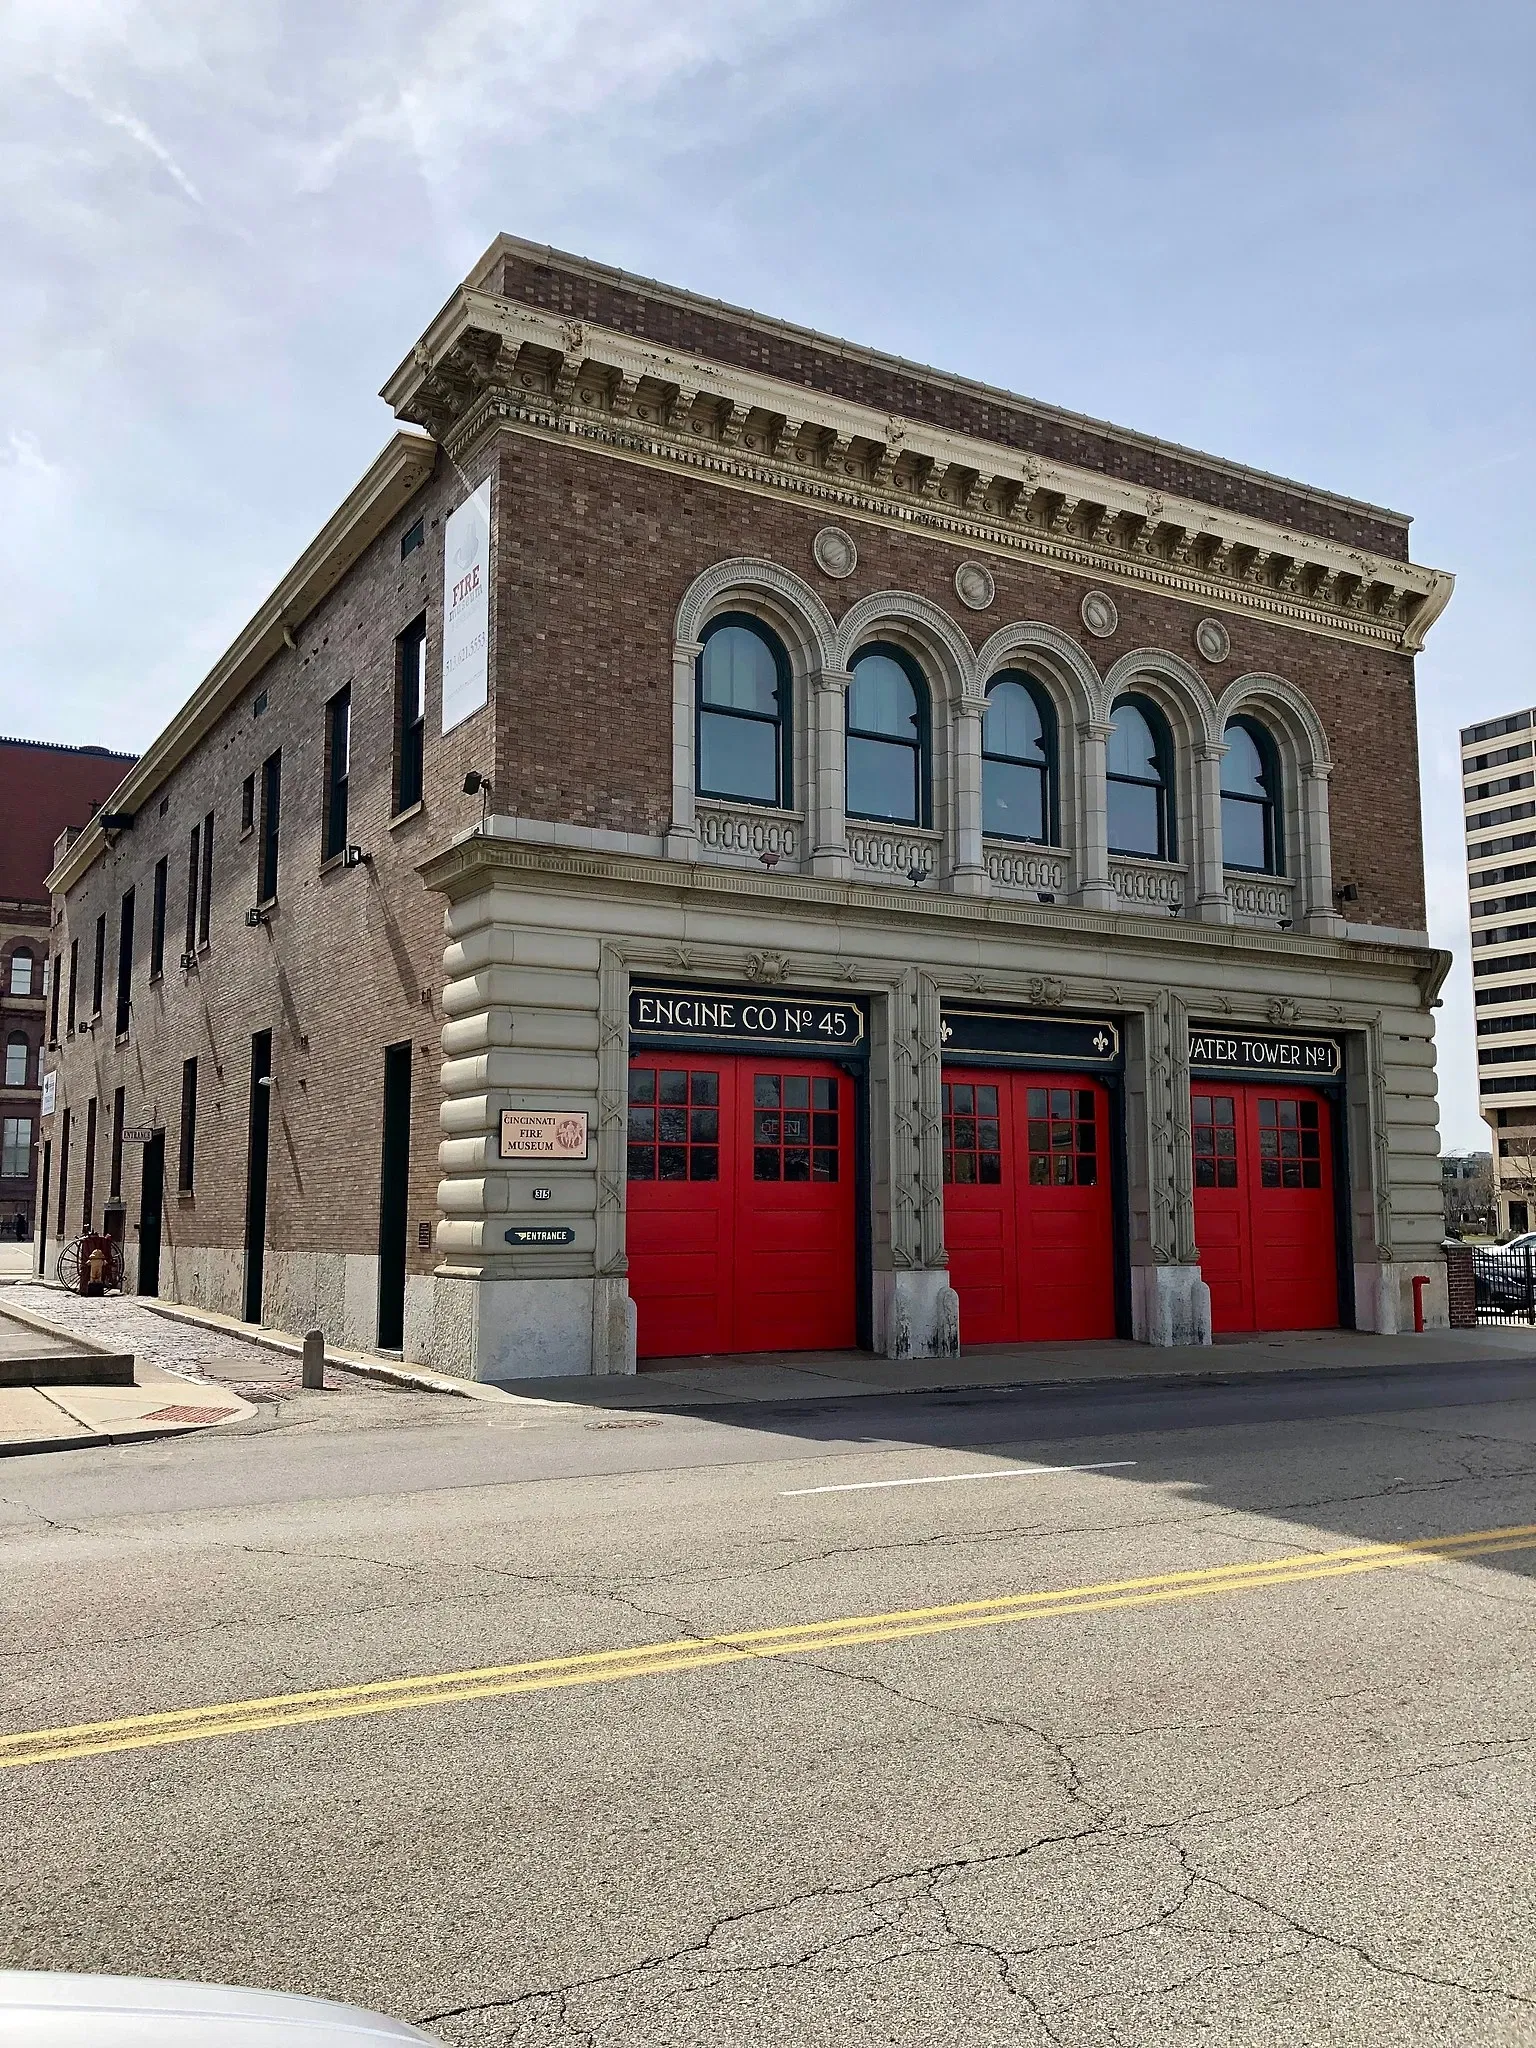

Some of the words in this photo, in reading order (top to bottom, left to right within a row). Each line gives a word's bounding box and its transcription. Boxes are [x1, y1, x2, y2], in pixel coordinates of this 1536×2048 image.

[452, 564, 480, 608] FIRE
[638, 998, 736, 1029] ENGINE
[742, 1005, 777, 1031] CO
[818, 1012, 848, 1036] 45
[1241, 1041, 1301, 1066] TOWER
[503, 1115, 556, 1126] CINCINNATI
[519, 1129, 543, 1138] FIRE
[507, 1141, 554, 1151] MUSEUM
[535, 1189, 549, 1198] 315
[526, 1231, 567, 1240] ENTRANCE
